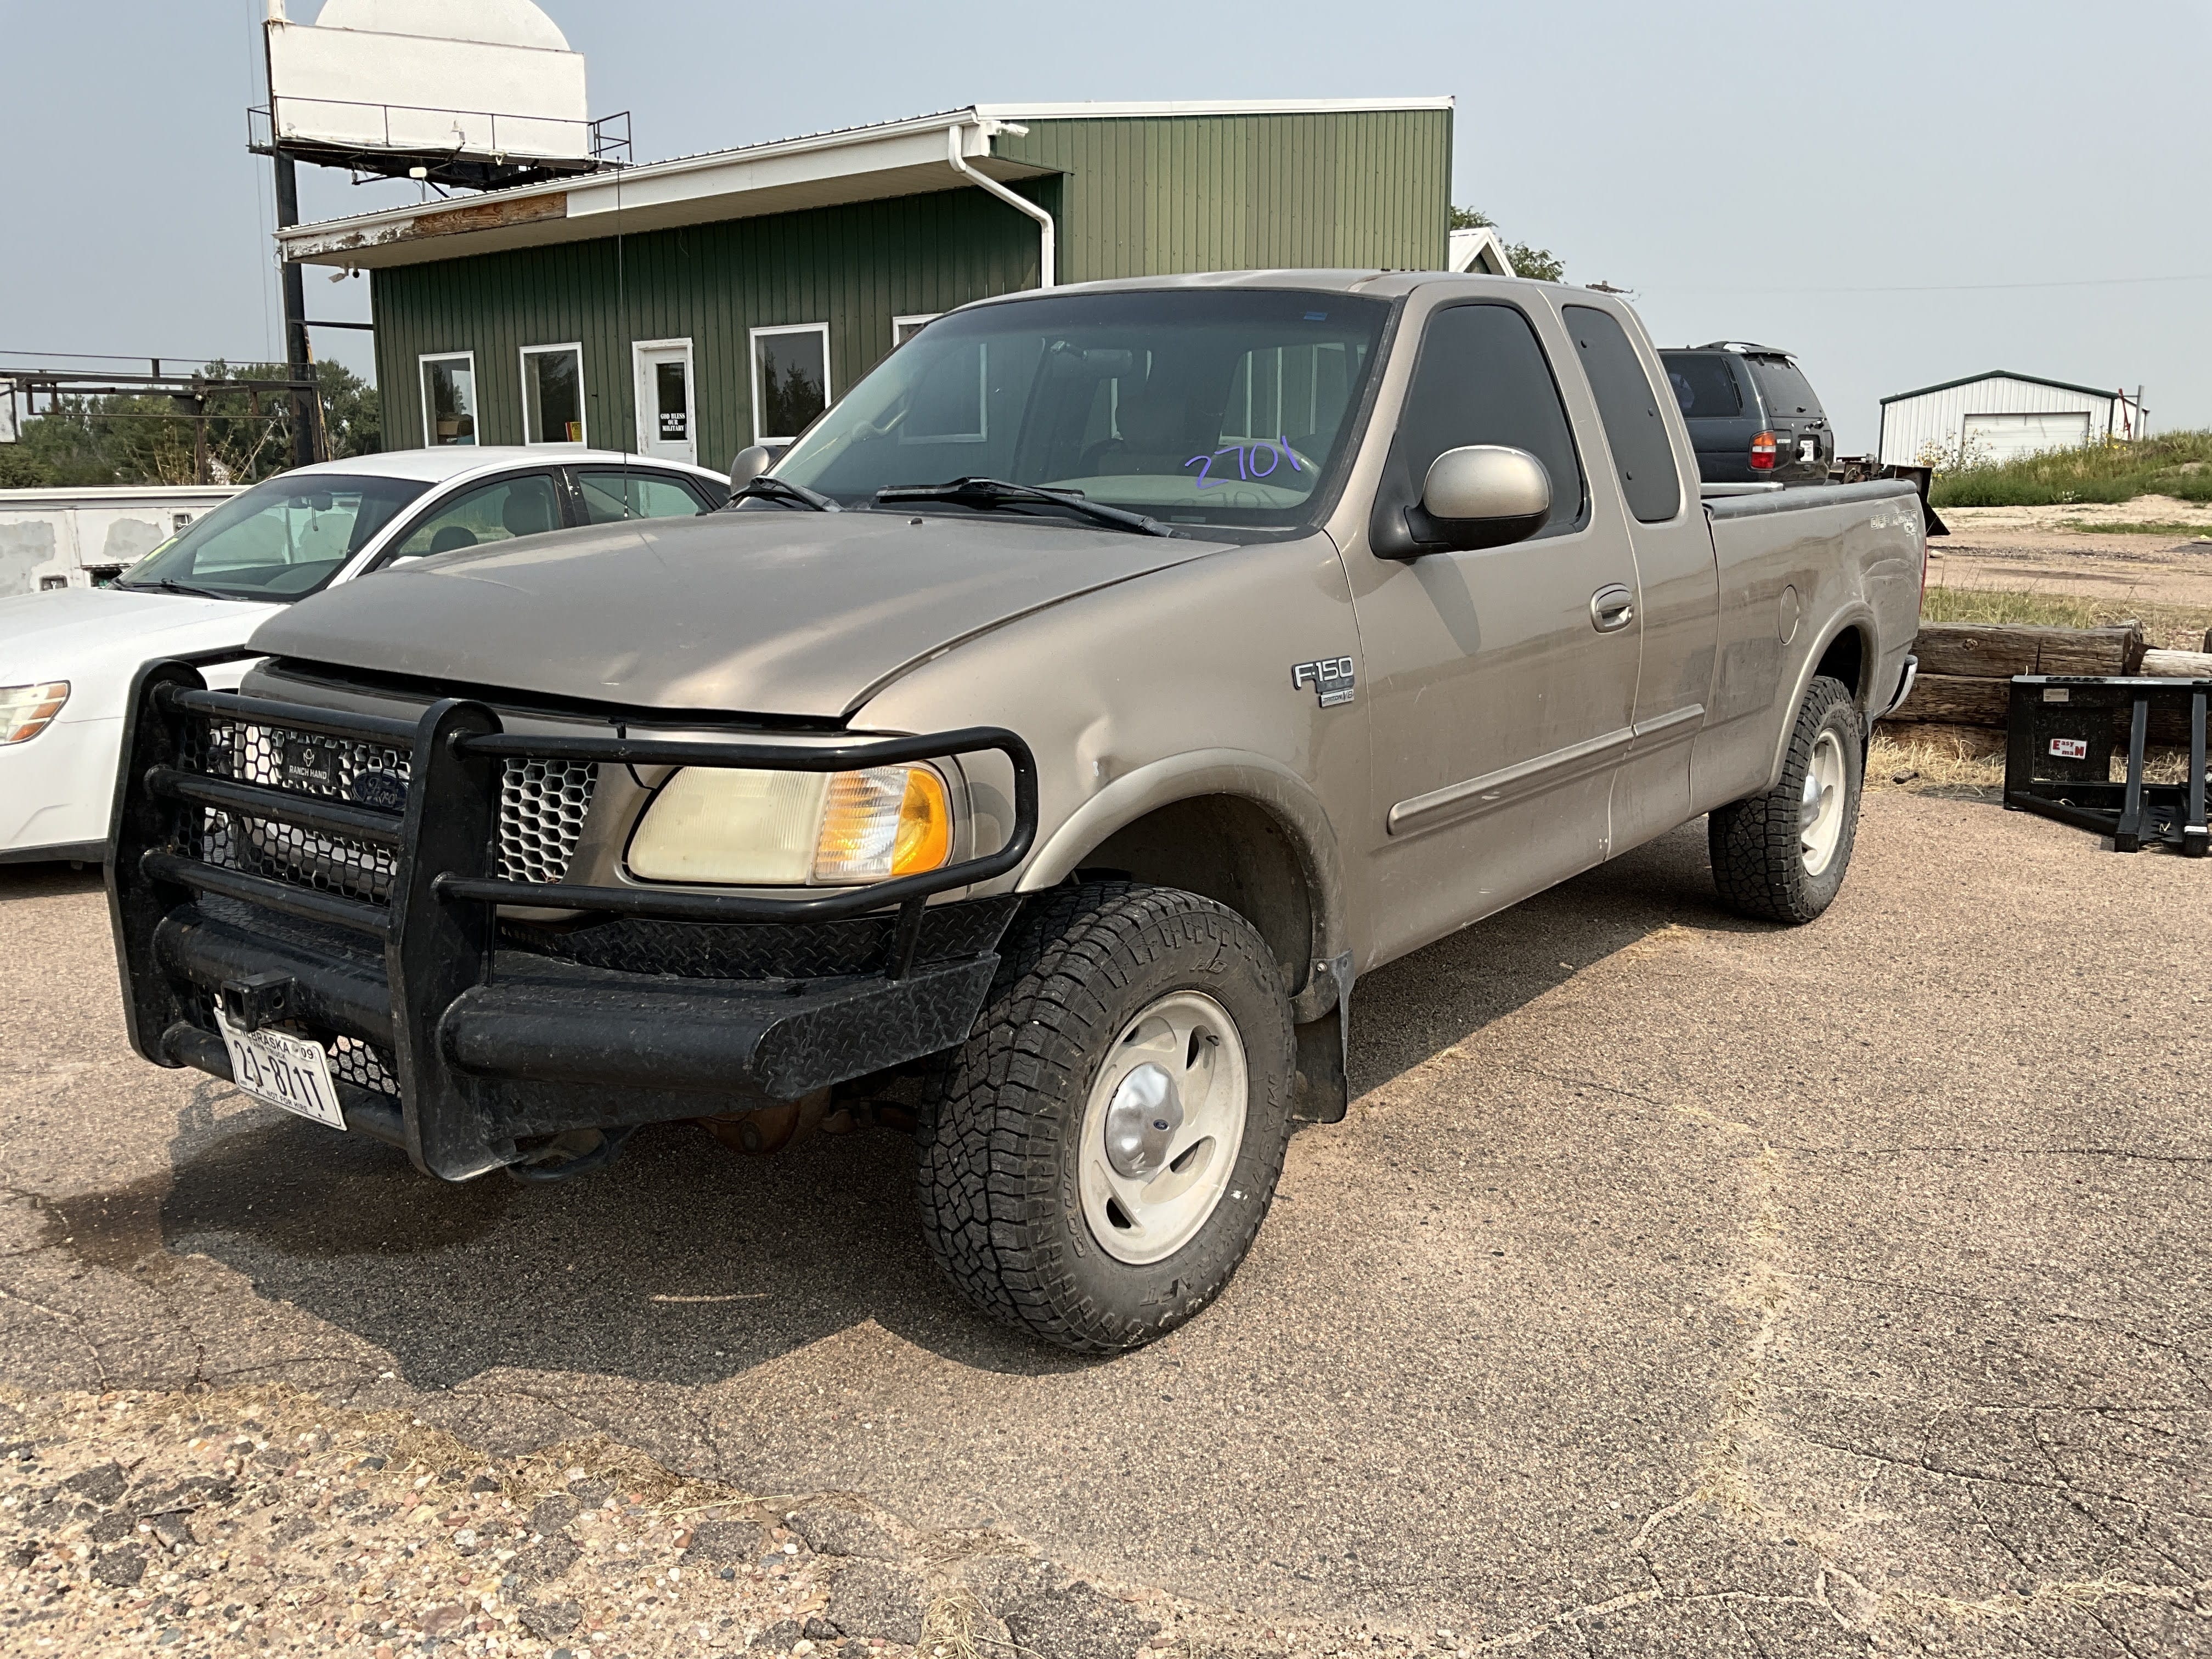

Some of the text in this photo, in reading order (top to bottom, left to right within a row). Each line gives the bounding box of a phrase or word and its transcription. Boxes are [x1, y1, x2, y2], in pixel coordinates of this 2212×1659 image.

[1184, 435, 1301, 489] 2701
[1871, 515, 1889, 529] OFF
[1342, 691, 1353, 701] V8
[2052, 740, 2075, 751] Easy
[289, 765, 327, 780] RANCH HAND
[240, 1031, 291, 1054] NEBRASKA
[267, 1047, 286, 1060] TRUCK
[301, 1047, 313, 1059] 09
[234, 1040, 325, 1111] 21-871T
[266, 1091, 308, 1113] NOT FOR HIRE
